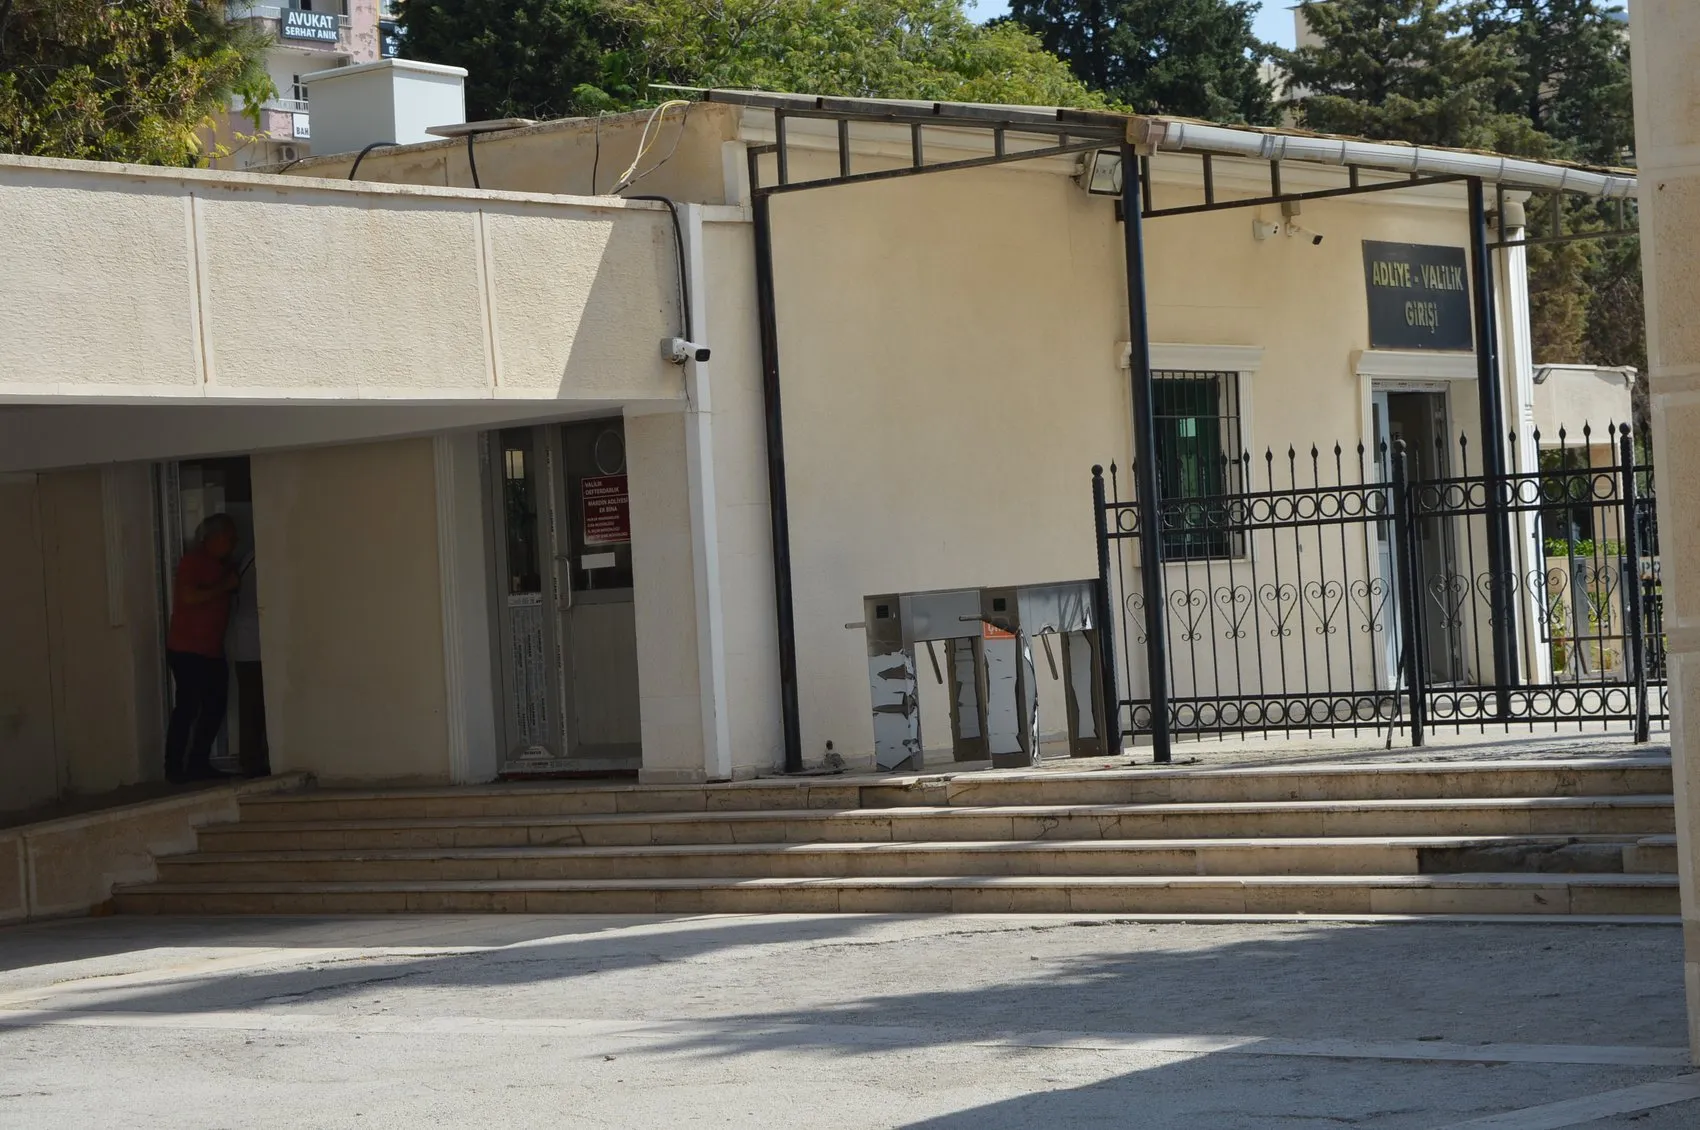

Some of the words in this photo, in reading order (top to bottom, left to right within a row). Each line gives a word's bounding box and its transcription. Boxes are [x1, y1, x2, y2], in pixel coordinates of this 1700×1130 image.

[288, 12, 333, 29] AVUKAT
[285, 26, 316, 38] SERHAT
[317, 29, 337, 40] ANIK
[1373, 261, 1412, 288] ADLİYE
[1420, 264, 1464, 291] VALİLİK
[1405, 300, 1439, 334] GİRİŞİ
